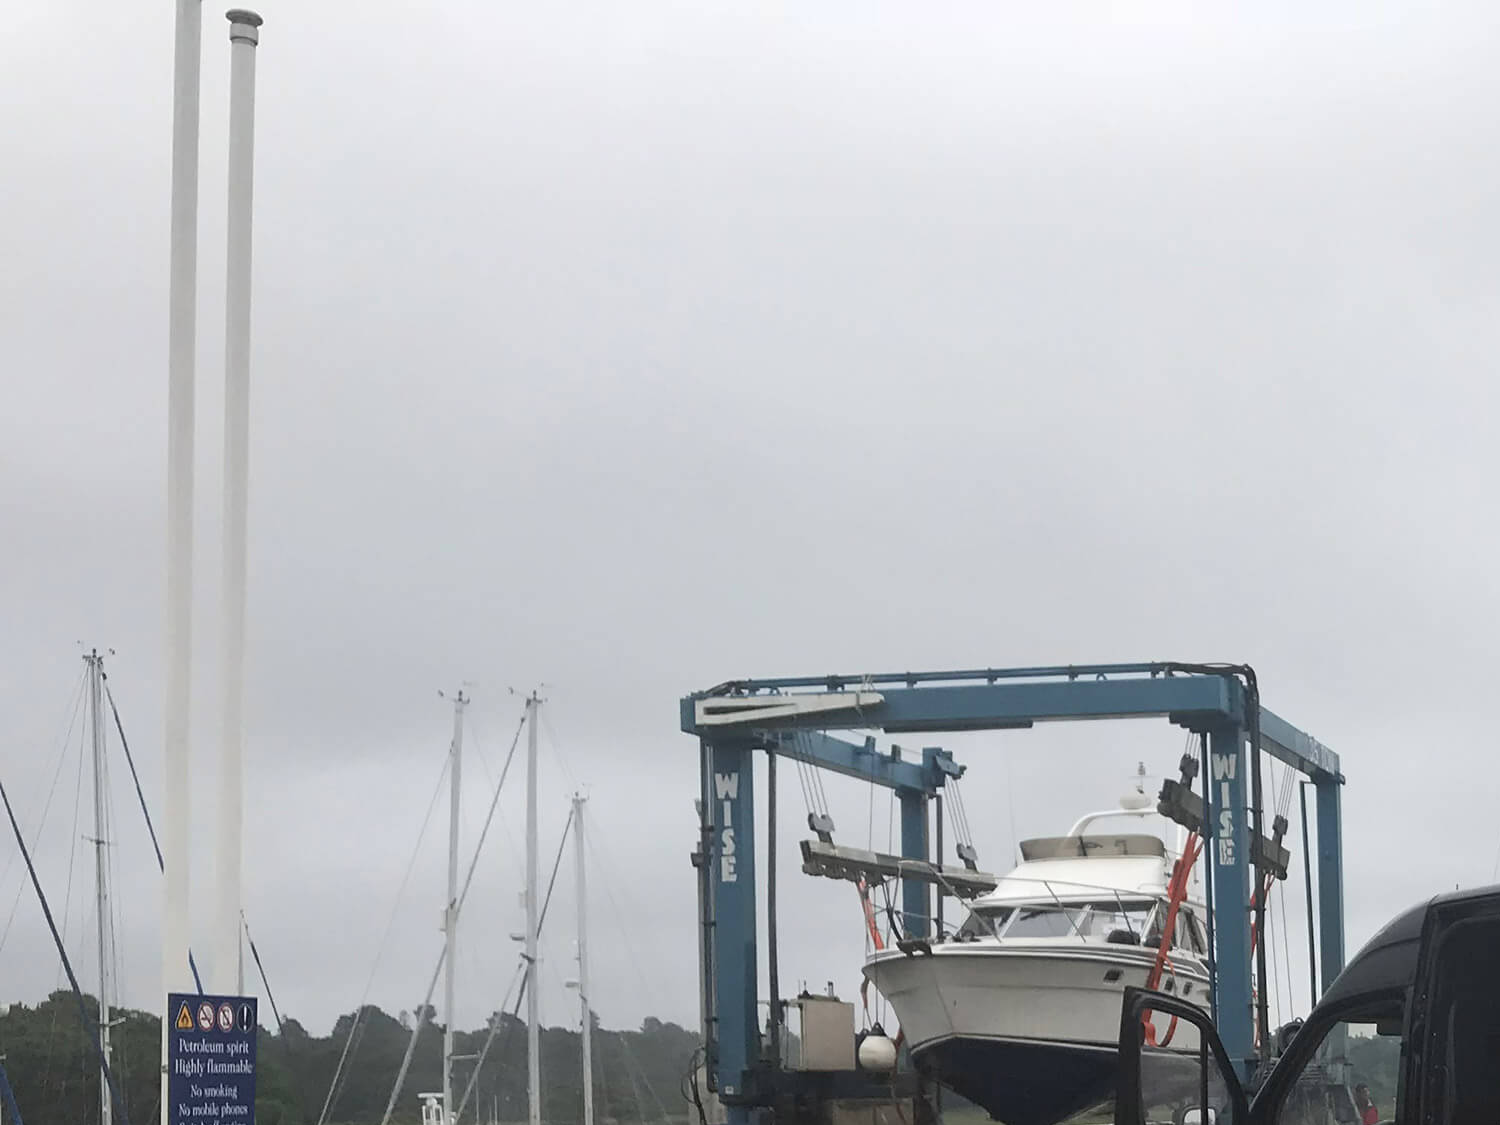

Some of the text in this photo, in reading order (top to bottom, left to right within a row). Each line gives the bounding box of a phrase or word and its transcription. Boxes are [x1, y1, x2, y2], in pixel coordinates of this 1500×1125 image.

[1212, 753, 1237, 865] WISE
[714, 772, 739, 882] WISE
[179, 1038, 249, 1057] Petroleum spirit
[175, 1058, 254, 1077] Highly flammable
[190, 1083, 238, 1100] No smoking
[178, 1102, 249, 1118] No mobile phones
